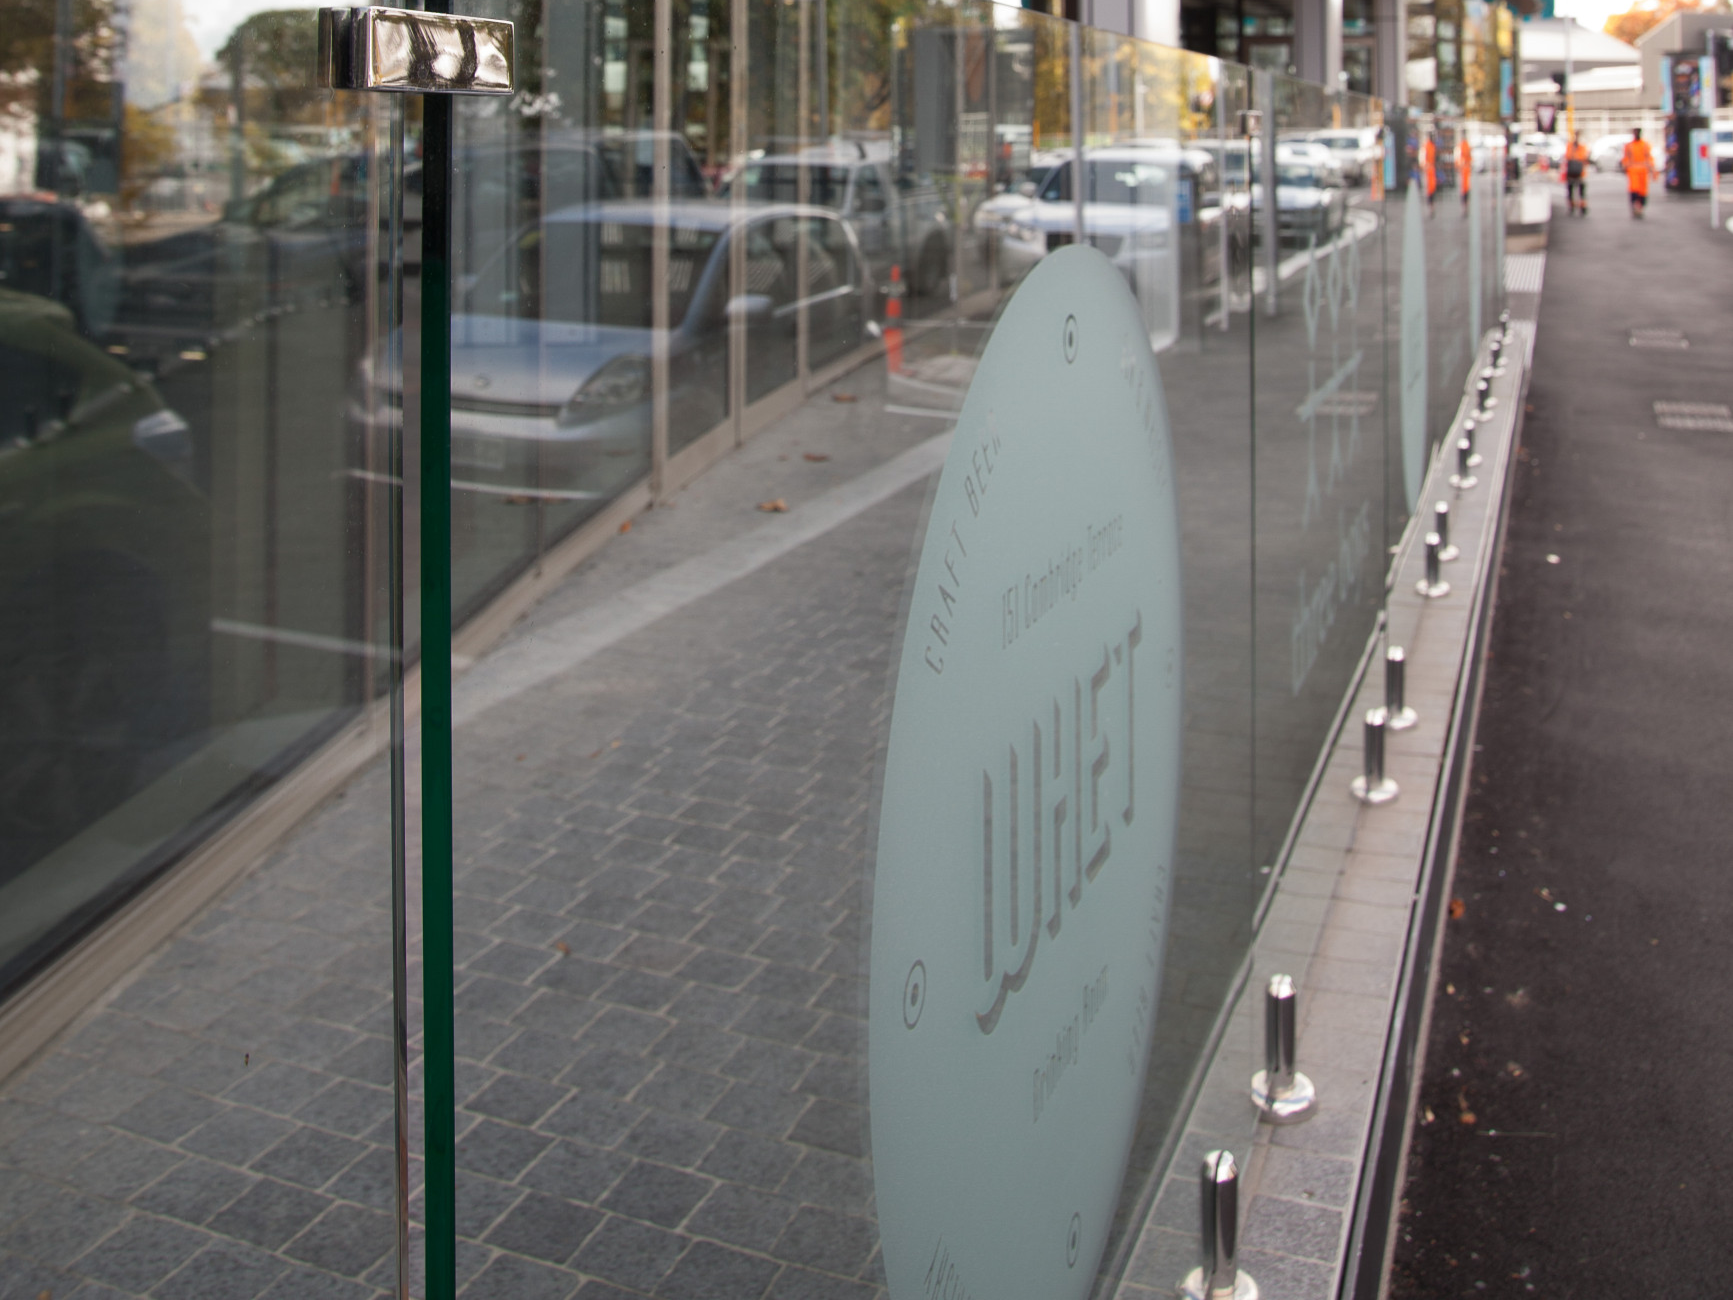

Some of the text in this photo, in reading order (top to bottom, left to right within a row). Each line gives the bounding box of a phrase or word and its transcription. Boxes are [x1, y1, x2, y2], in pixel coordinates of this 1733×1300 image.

[924, 517, 967, 676] CRAFT
[1001, 513, 1123, 650] 151 Cambridge Terrace
[974, 608, 1142, 1036] WHET
